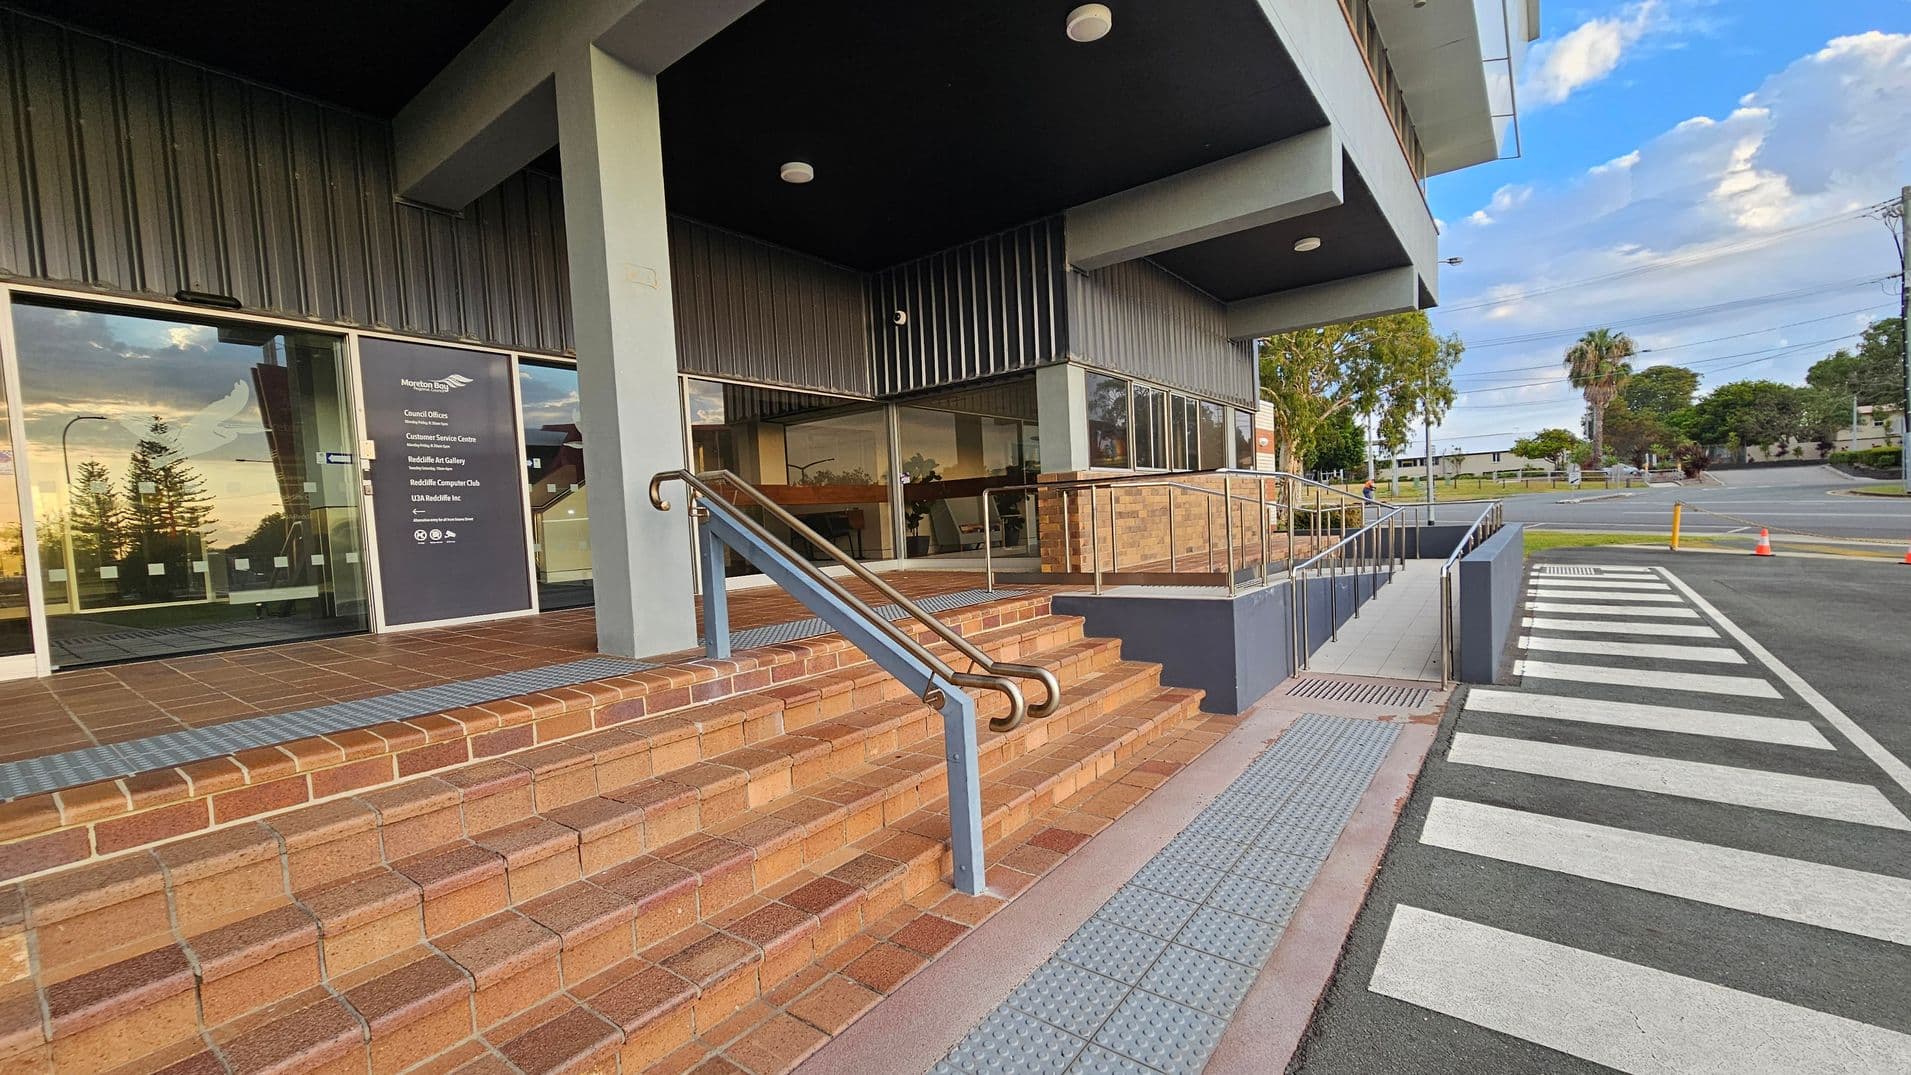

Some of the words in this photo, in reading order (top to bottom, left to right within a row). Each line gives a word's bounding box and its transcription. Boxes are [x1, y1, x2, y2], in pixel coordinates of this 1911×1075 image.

[401, 378, 432, 388] Moreton
[434, 382, 449, 392] Bay
[404, 409, 427, 417] Council
[428, 411, 448, 419] Offices
[406, 432, 435, 441] Customer
[436, 434, 457, 442] Service
[408, 455, 434, 463] Redcliffe
[445, 457, 465, 465] Gallery
[410, 478, 436, 486] Redcliffe
[437, 479, 466, 487] Computer
[426, 494, 451, 502] Redcliffe
